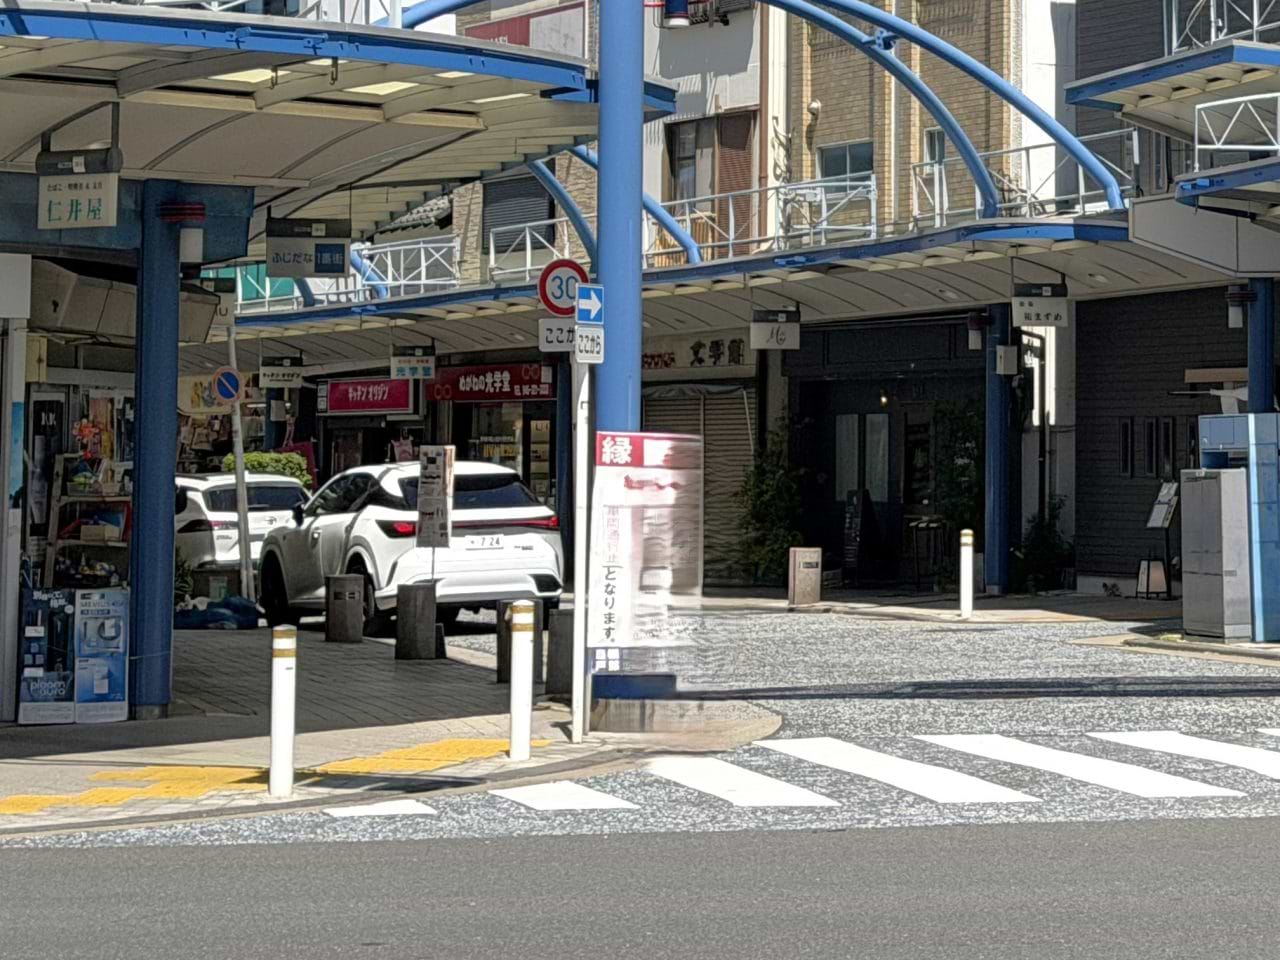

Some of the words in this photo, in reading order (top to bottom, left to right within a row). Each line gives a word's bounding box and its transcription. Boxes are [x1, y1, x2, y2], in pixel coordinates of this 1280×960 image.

[550, 274, 577, 301] 30
[545, 326, 576, 343] ここか
[578, 334, 602, 354] ここから
